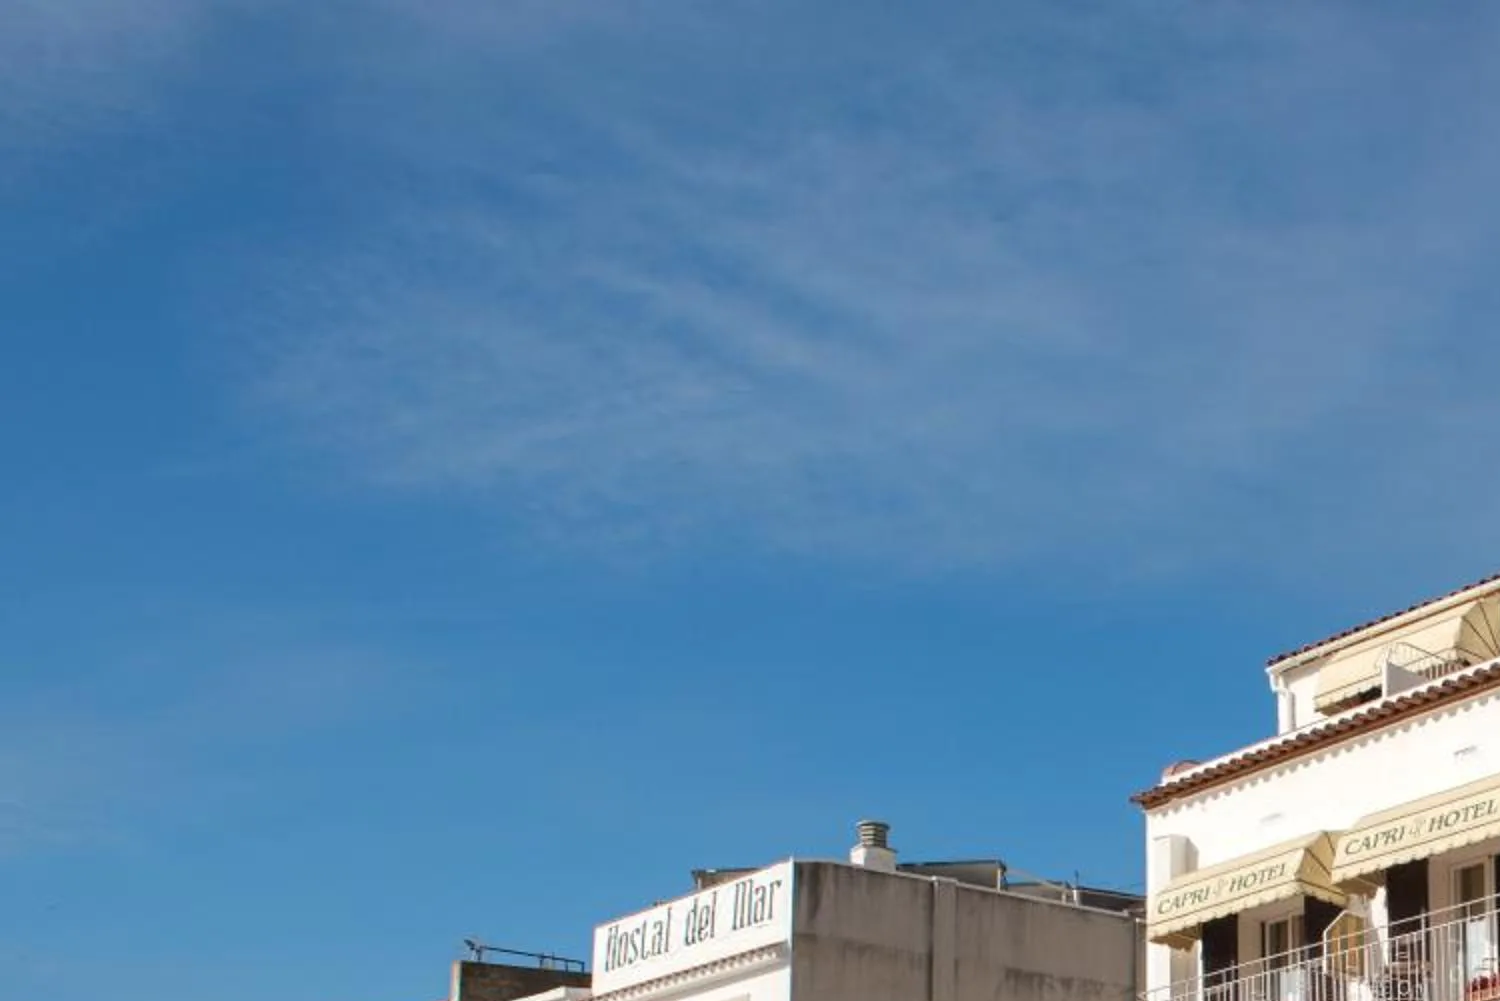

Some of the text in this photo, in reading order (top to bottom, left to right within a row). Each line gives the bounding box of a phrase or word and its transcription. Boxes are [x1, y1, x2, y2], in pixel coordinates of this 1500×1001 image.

[1344, 797, 1499, 856] CAPRI HOTEL
[1156, 861, 1289, 916] CAPRI HOTEL
[604, 878, 782, 973] Hostal del Mar
